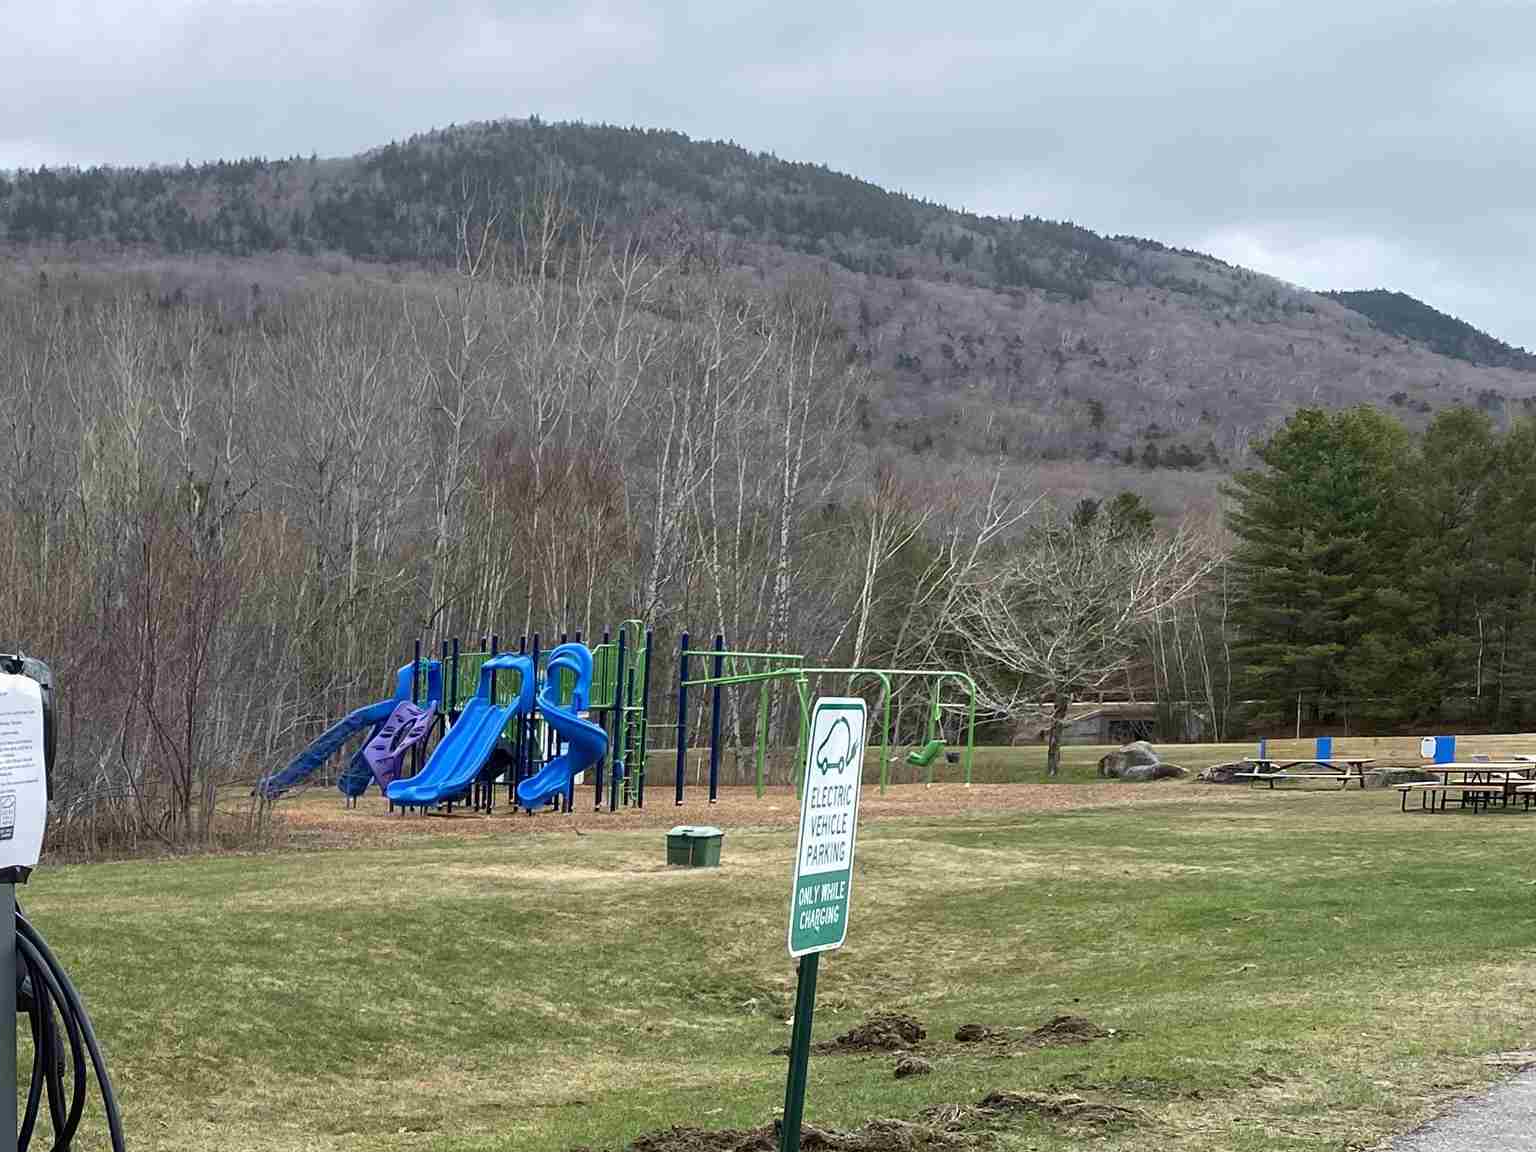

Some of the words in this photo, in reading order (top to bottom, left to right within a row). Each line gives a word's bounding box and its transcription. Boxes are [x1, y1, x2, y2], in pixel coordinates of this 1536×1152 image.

[811, 784, 852, 808] ELECTRIC
[811, 813, 848, 836] VEHICLE
[806, 841, 845, 866] PARKING
[799, 886, 820, 905] ONLY
[821, 881, 845, 902] WHILE
[800, 904, 839, 929] CHARGING
